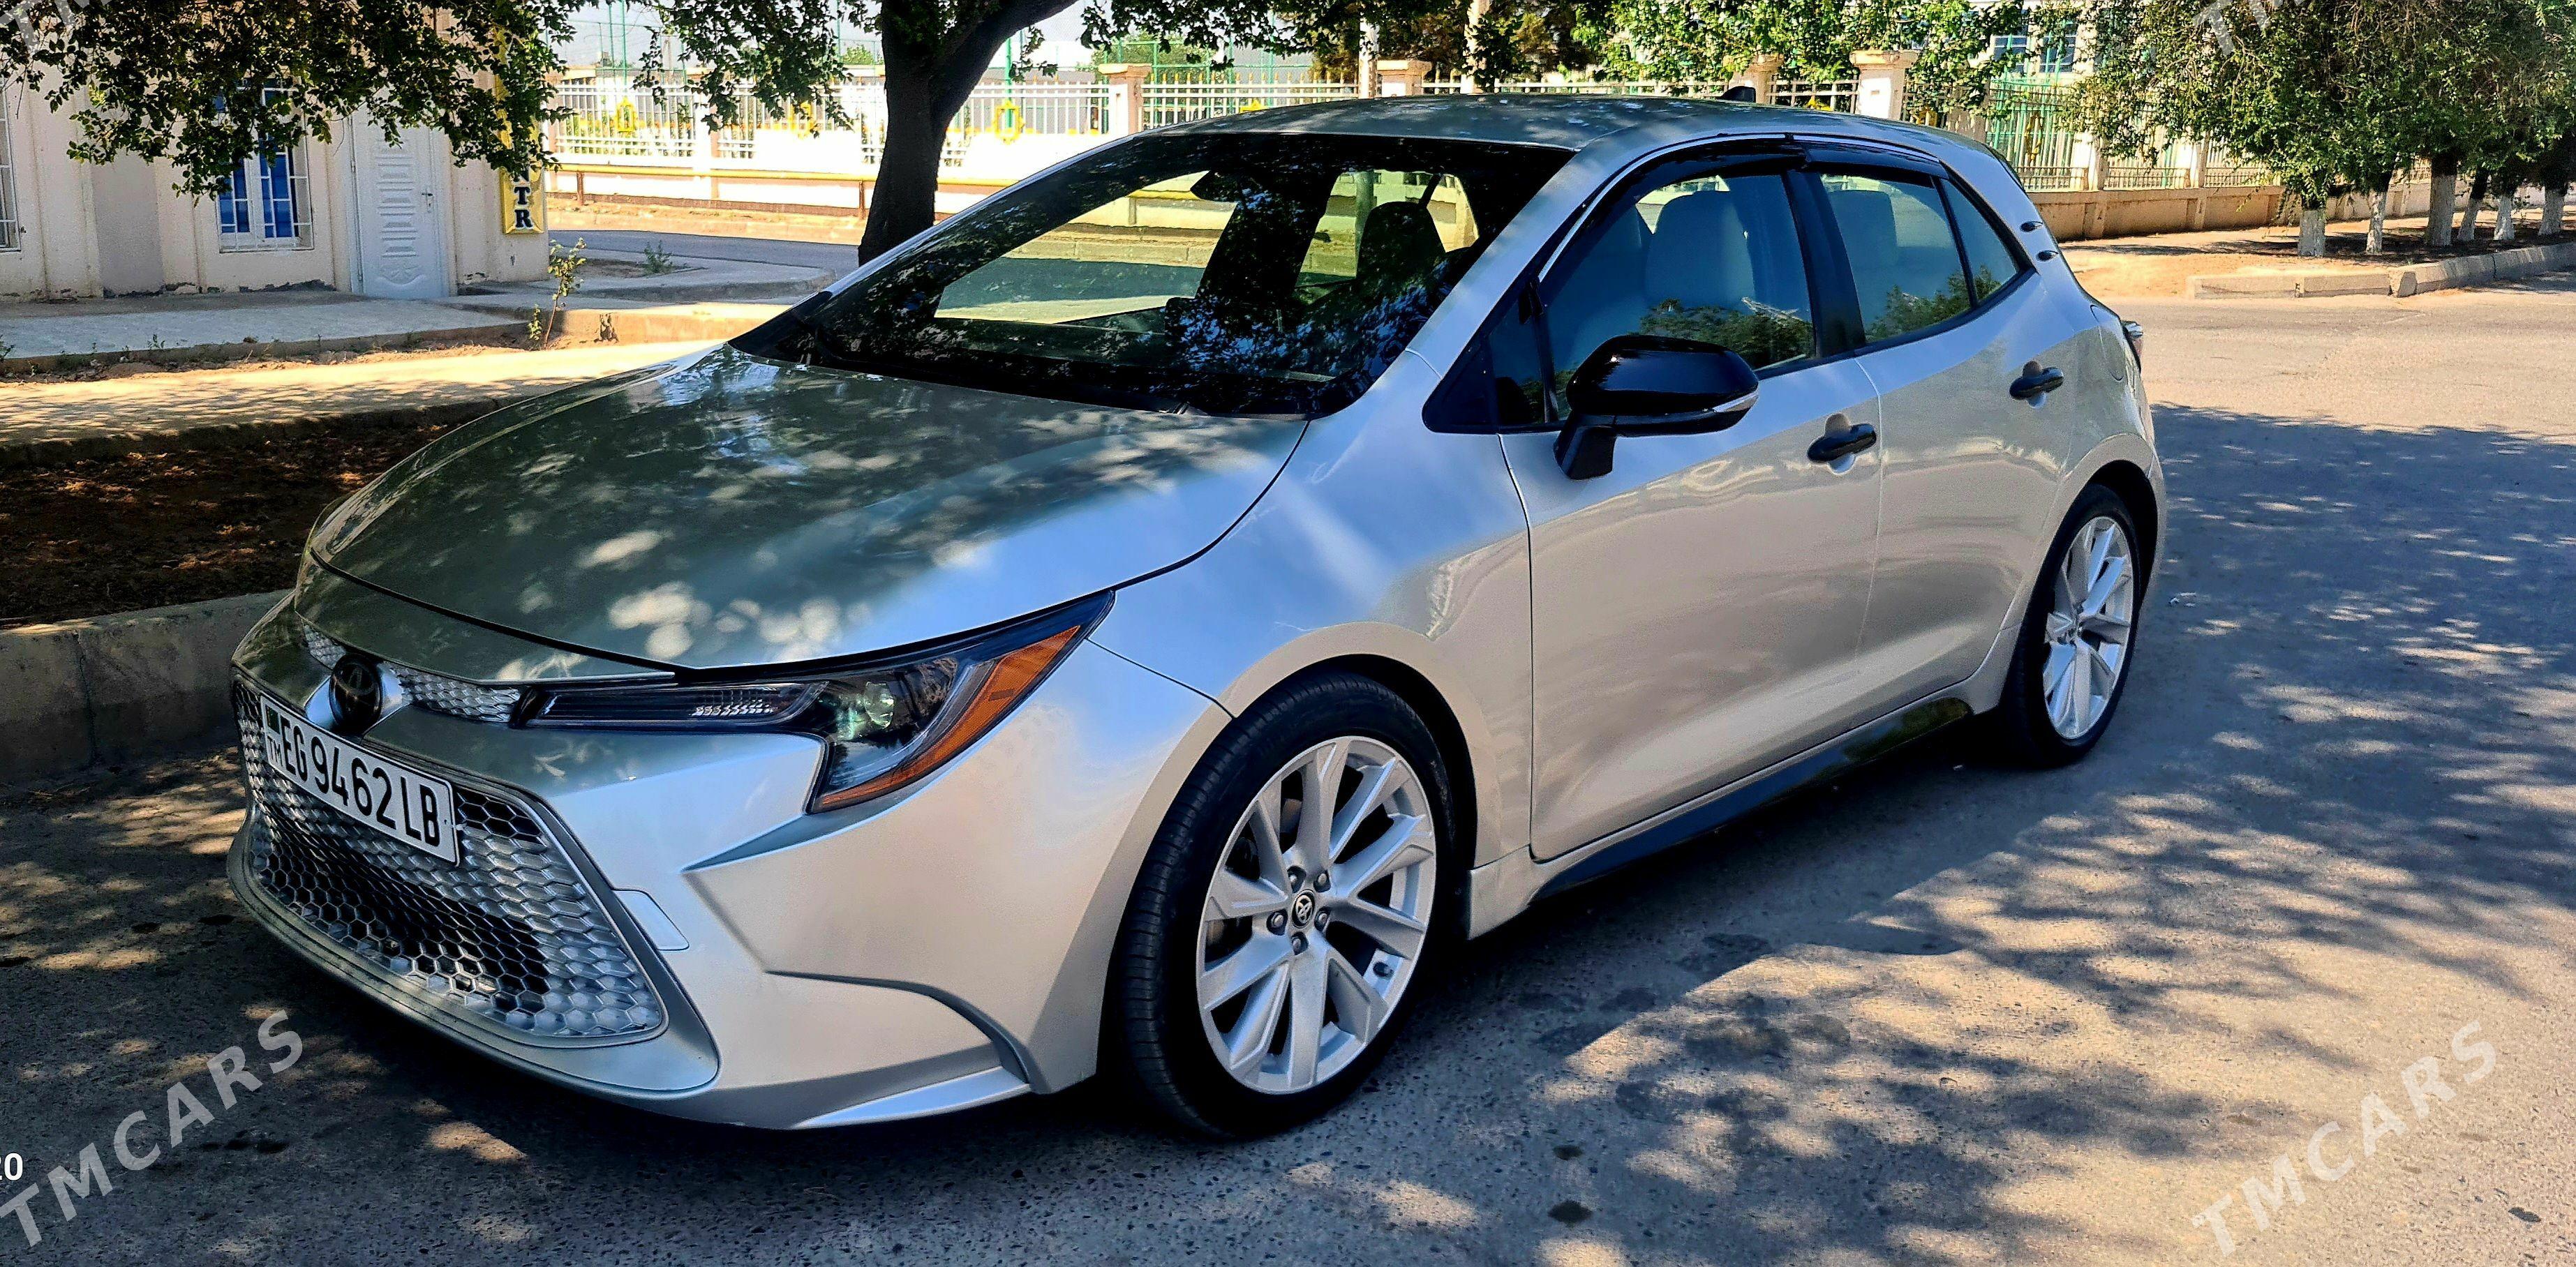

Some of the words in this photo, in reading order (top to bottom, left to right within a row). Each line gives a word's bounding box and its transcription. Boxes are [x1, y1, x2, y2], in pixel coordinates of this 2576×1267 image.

[267, 735, 283, 767] TM
[281, 714, 308, 782] EG
[311, 736, 396, 830] 9462
[400, 776, 441, 847] LB
